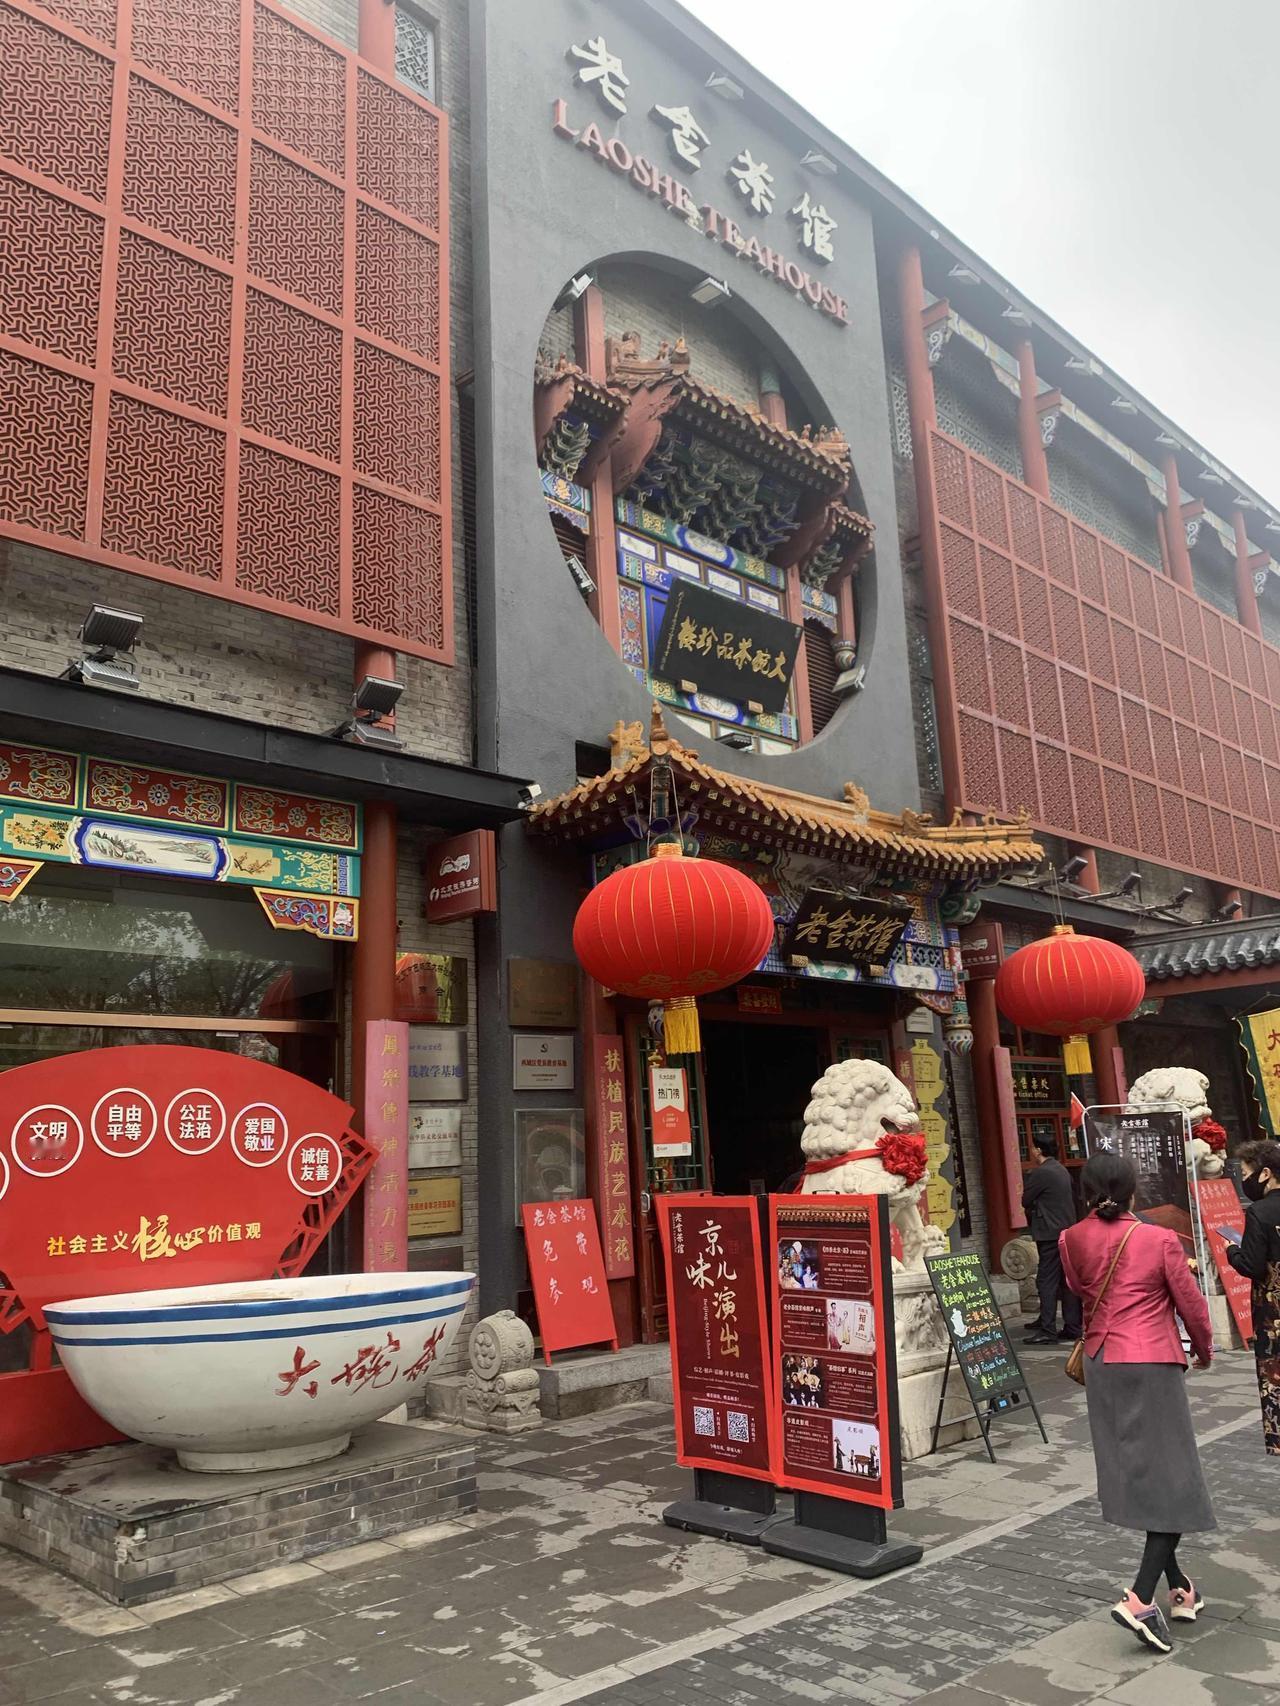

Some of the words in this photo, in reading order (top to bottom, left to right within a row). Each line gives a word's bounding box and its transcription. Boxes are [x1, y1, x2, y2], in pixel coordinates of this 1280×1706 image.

[565, 36, 838, 263] 老舍茶馆
[553, 98, 698, 222] LAOSHE
[702, 202, 852, 327] TEAHOUSE
[794, 905, 905, 954] 老舍茶馆
[108, 1104, 142, 1123] 自由
[179, 1105, 212, 1122] 公正
[29, 1121, 68, 1140] 文明
[107, 1123, 142, 1141] 平等
[179, 1122, 212, 1140] 法治
[245, 1118, 275, 1135] 爱国
[244, 1135, 275, 1152] 敬业
[300, 1148, 329, 1165] 诚信
[604, 1049, 631, 1263] 扶植民族艺术花
[300, 1165, 330, 1182] 友善
[534, 1205, 586, 1227] 老舍茶馆
[47, 1214, 262, 1263] 社会主义核心价值观
[929, 1258, 954, 1273] LAOSHE
[954, 1254, 981, 1268] TEAHOUSE
